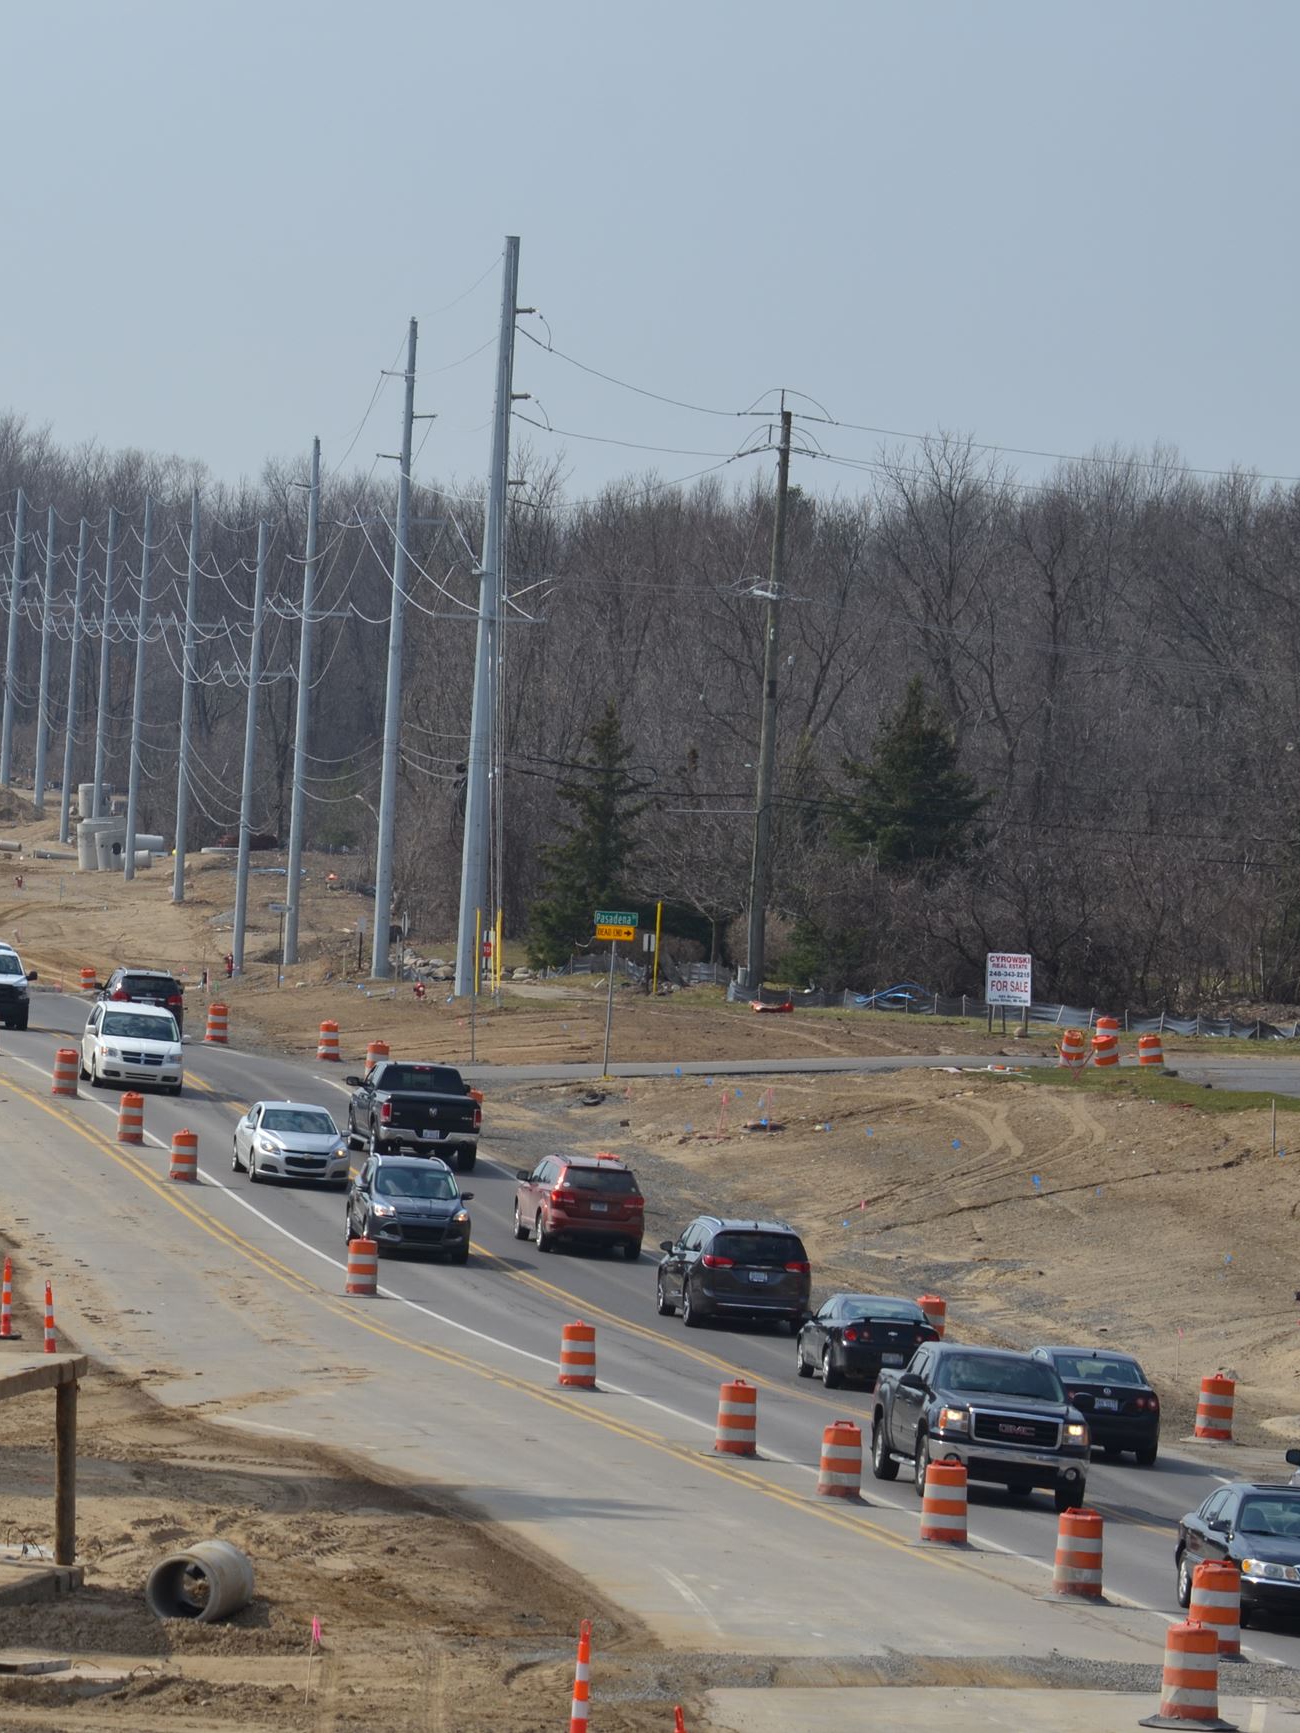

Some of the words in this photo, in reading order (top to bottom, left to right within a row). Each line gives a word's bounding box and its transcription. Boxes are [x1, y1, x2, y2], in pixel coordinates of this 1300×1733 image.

[596, 913, 631, 924] Pasadena
[598, 928, 611, 936] DEAD
[990, 955, 1030, 964] CYROWSKI
[991, 980, 1008, 992] FOR
[1010, 981, 1028, 993] SALE
[999, 1423, 1035, 1436] GMC
